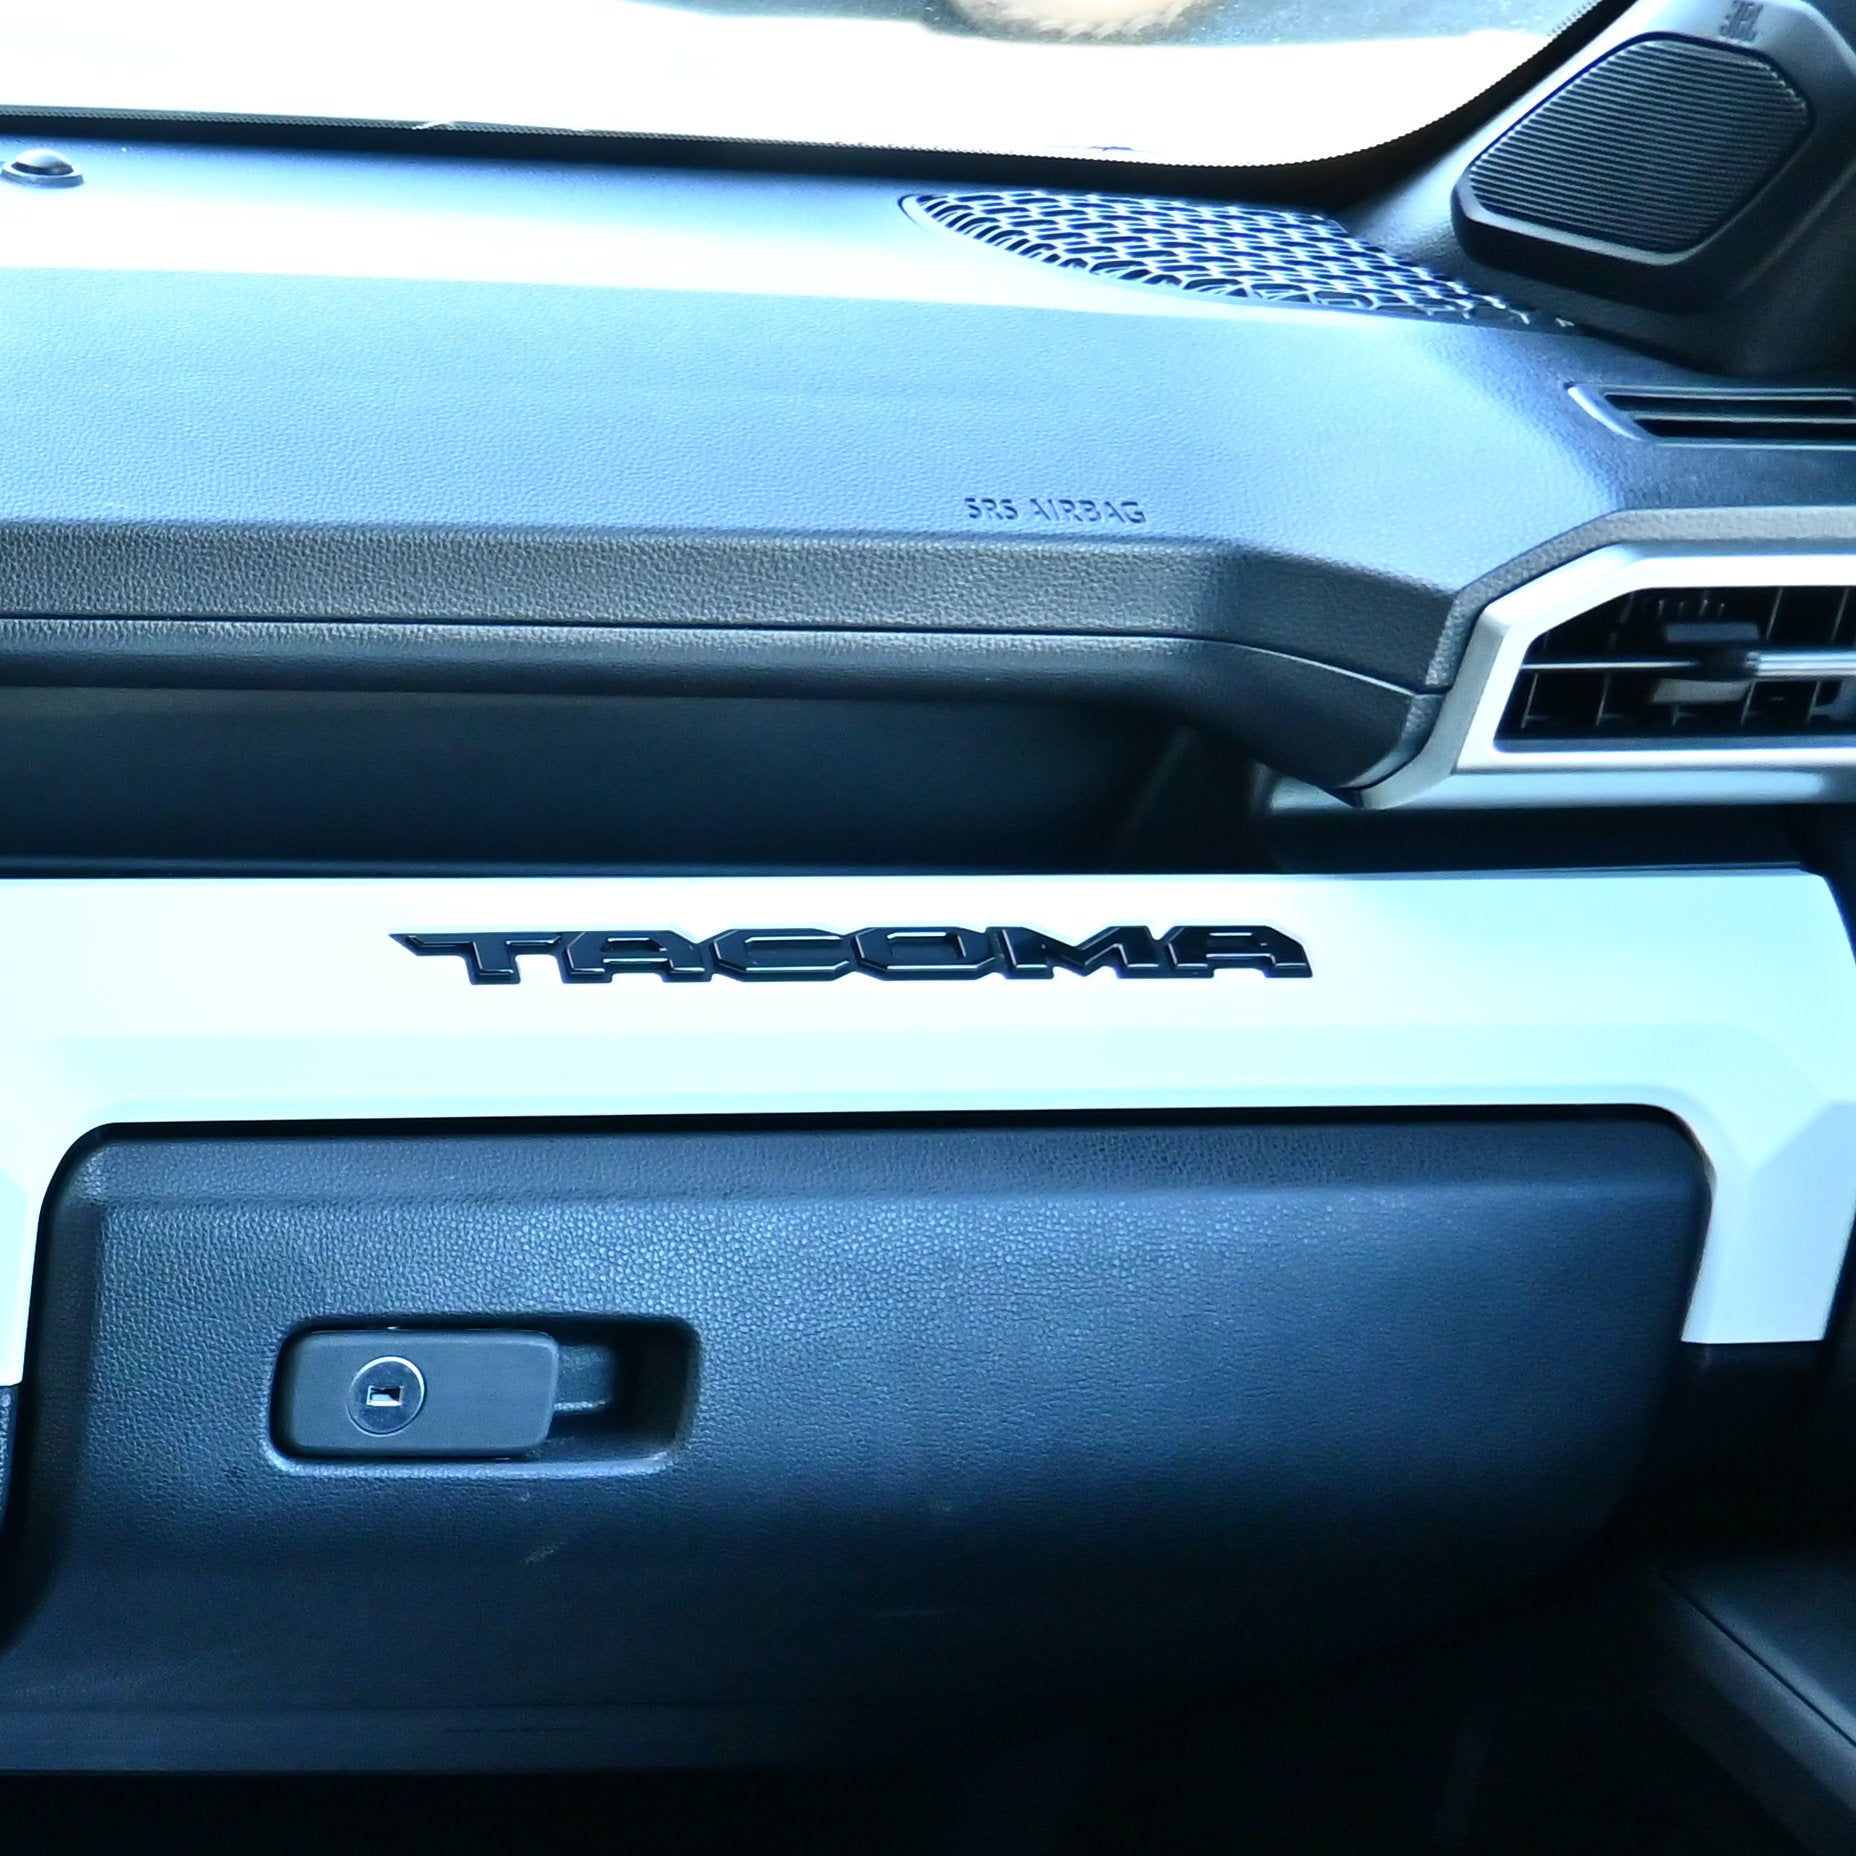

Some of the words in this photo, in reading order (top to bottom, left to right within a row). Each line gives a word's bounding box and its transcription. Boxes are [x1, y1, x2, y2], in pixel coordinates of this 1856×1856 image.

[963, 496, 1019, 521] SRS
[1029, 498, 1148, 524] AIRBAG
[388, 925, 1313, 985] TACOMA
